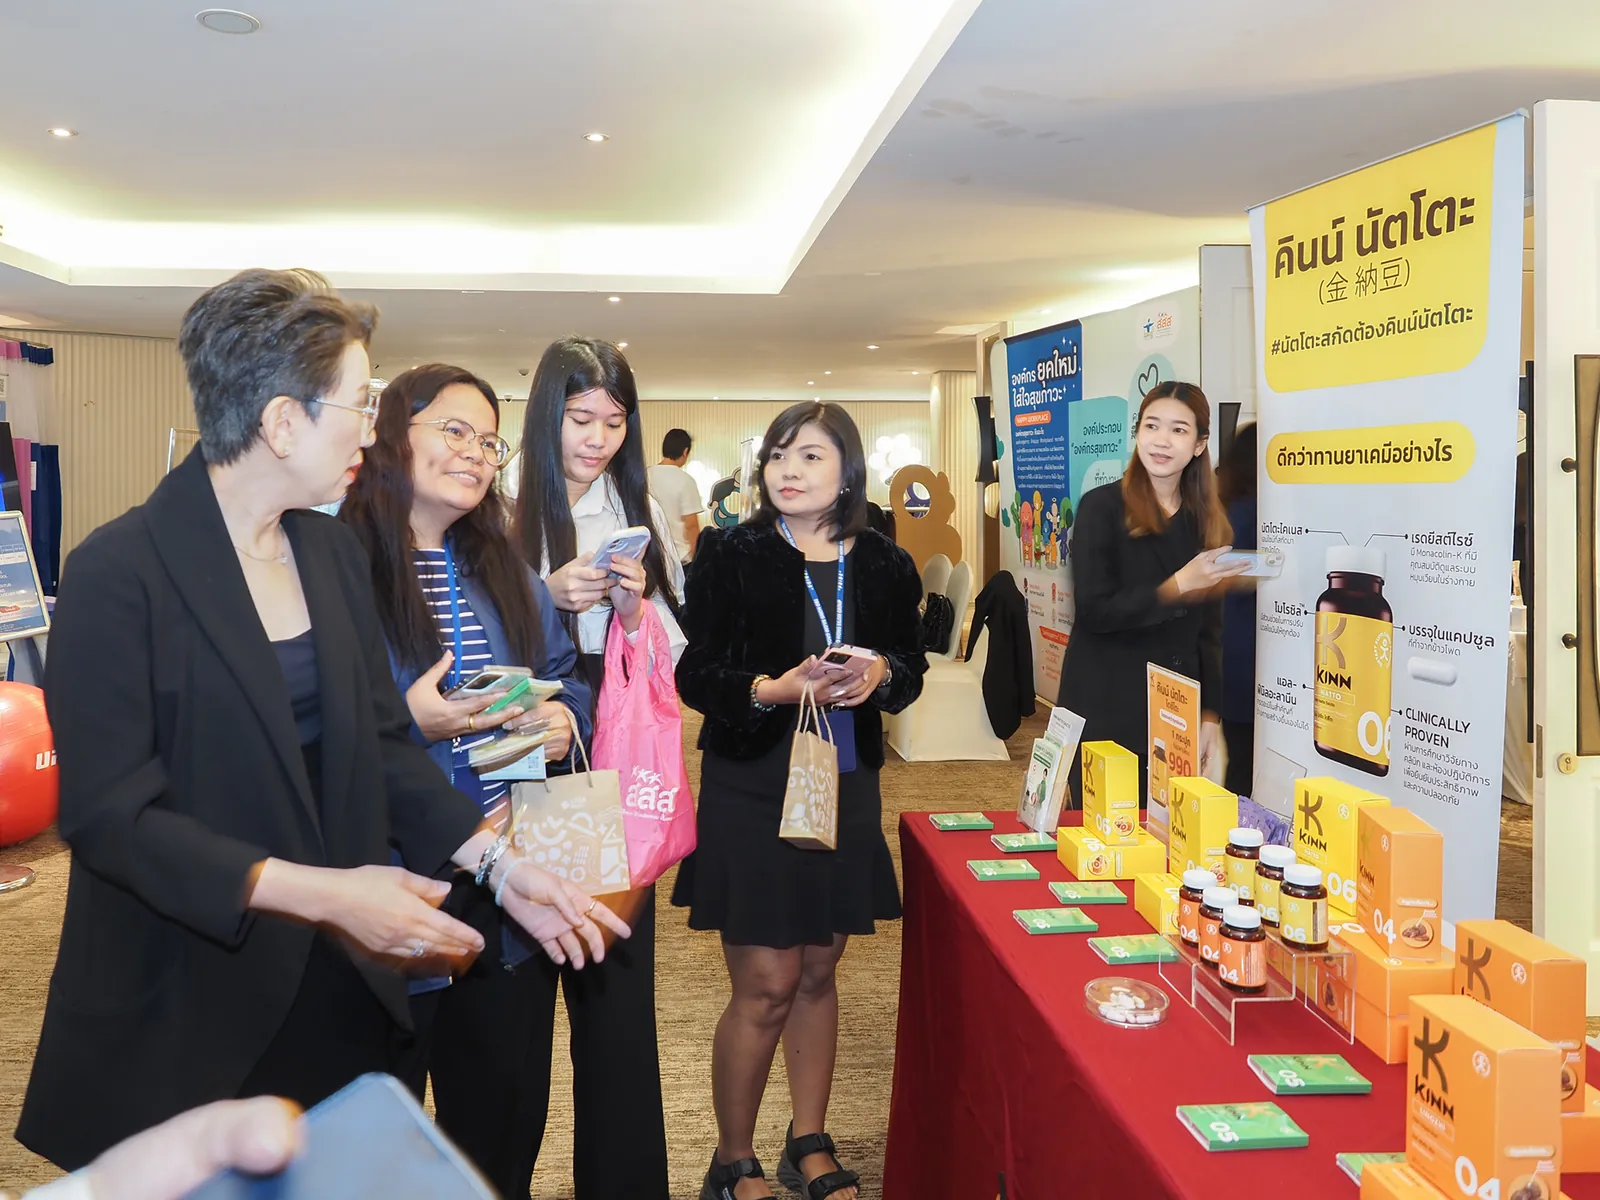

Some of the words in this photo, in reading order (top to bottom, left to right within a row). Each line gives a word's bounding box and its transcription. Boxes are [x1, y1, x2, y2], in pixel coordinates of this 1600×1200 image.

[1275, 216, 1346, 279] คินน์
[1356, 189, 1475, 258] นัตโตะ
[1271, 303, 1474, 356] #นัตโตะสกัดต้องคินน์นัตโตะ
[1012, 368, 1036, 386] องค์กร
[1037, 346, 1077, 388] ยุคใหม่
[1012, 387, 1063, 410] ใส่ใจสุขภาวะ
[1083, 421, 1122, 436] องค์ประกอบ
[1277, 438, 1453, 468] ดีกว่าทานยาเคมีอย่างไร
[1411, 531, 1474, 547] เรดยีสต์ไรซ์
[1416, 548, 1462, 560] Monacolin-K
[1464, 549, 1478, 561] ที่มี
[1409, 624, 1495, 650] บรรจุในแคปซูล
[1316, 664, 1352, 690] KINN
[1405, 707, 1471, 733] CLINICALLY
[1404, 725, 1449, 748] PROVEN
[1168, 752, 1191, 777] 990
[1404, 741, 1479, 770] ผ่านการศึกษาวิจัยทาง
[1403, 765, 1479, 797] เพื่อยืนยันประสิทธิภาพ
[1403, 780, 1460, 806] และความปลอดภัย
[625, 782, 679, 813] สสส
[1096, 813, 1112, 836] 06
[1171, 821, 1187, 842] KINN
[1299, 828, 1328, 852] KINN
[1359, 858, 1375, 887] KINN
[1327, 871, 1358, 904] 06
[1257, 903, 1278, 921] 06
[1180, 925, 1198, 942] 04
[1283, 924, 1307, 942] 06
[1374, 908, 1397, 944] 04
[1219, 964, 1239, 984] 04
[1414, 1074, 1454, 1122] KINN
[1209, 1121, 1240, 1143] 05
[1454, 1155, 1500, 1200] 04
